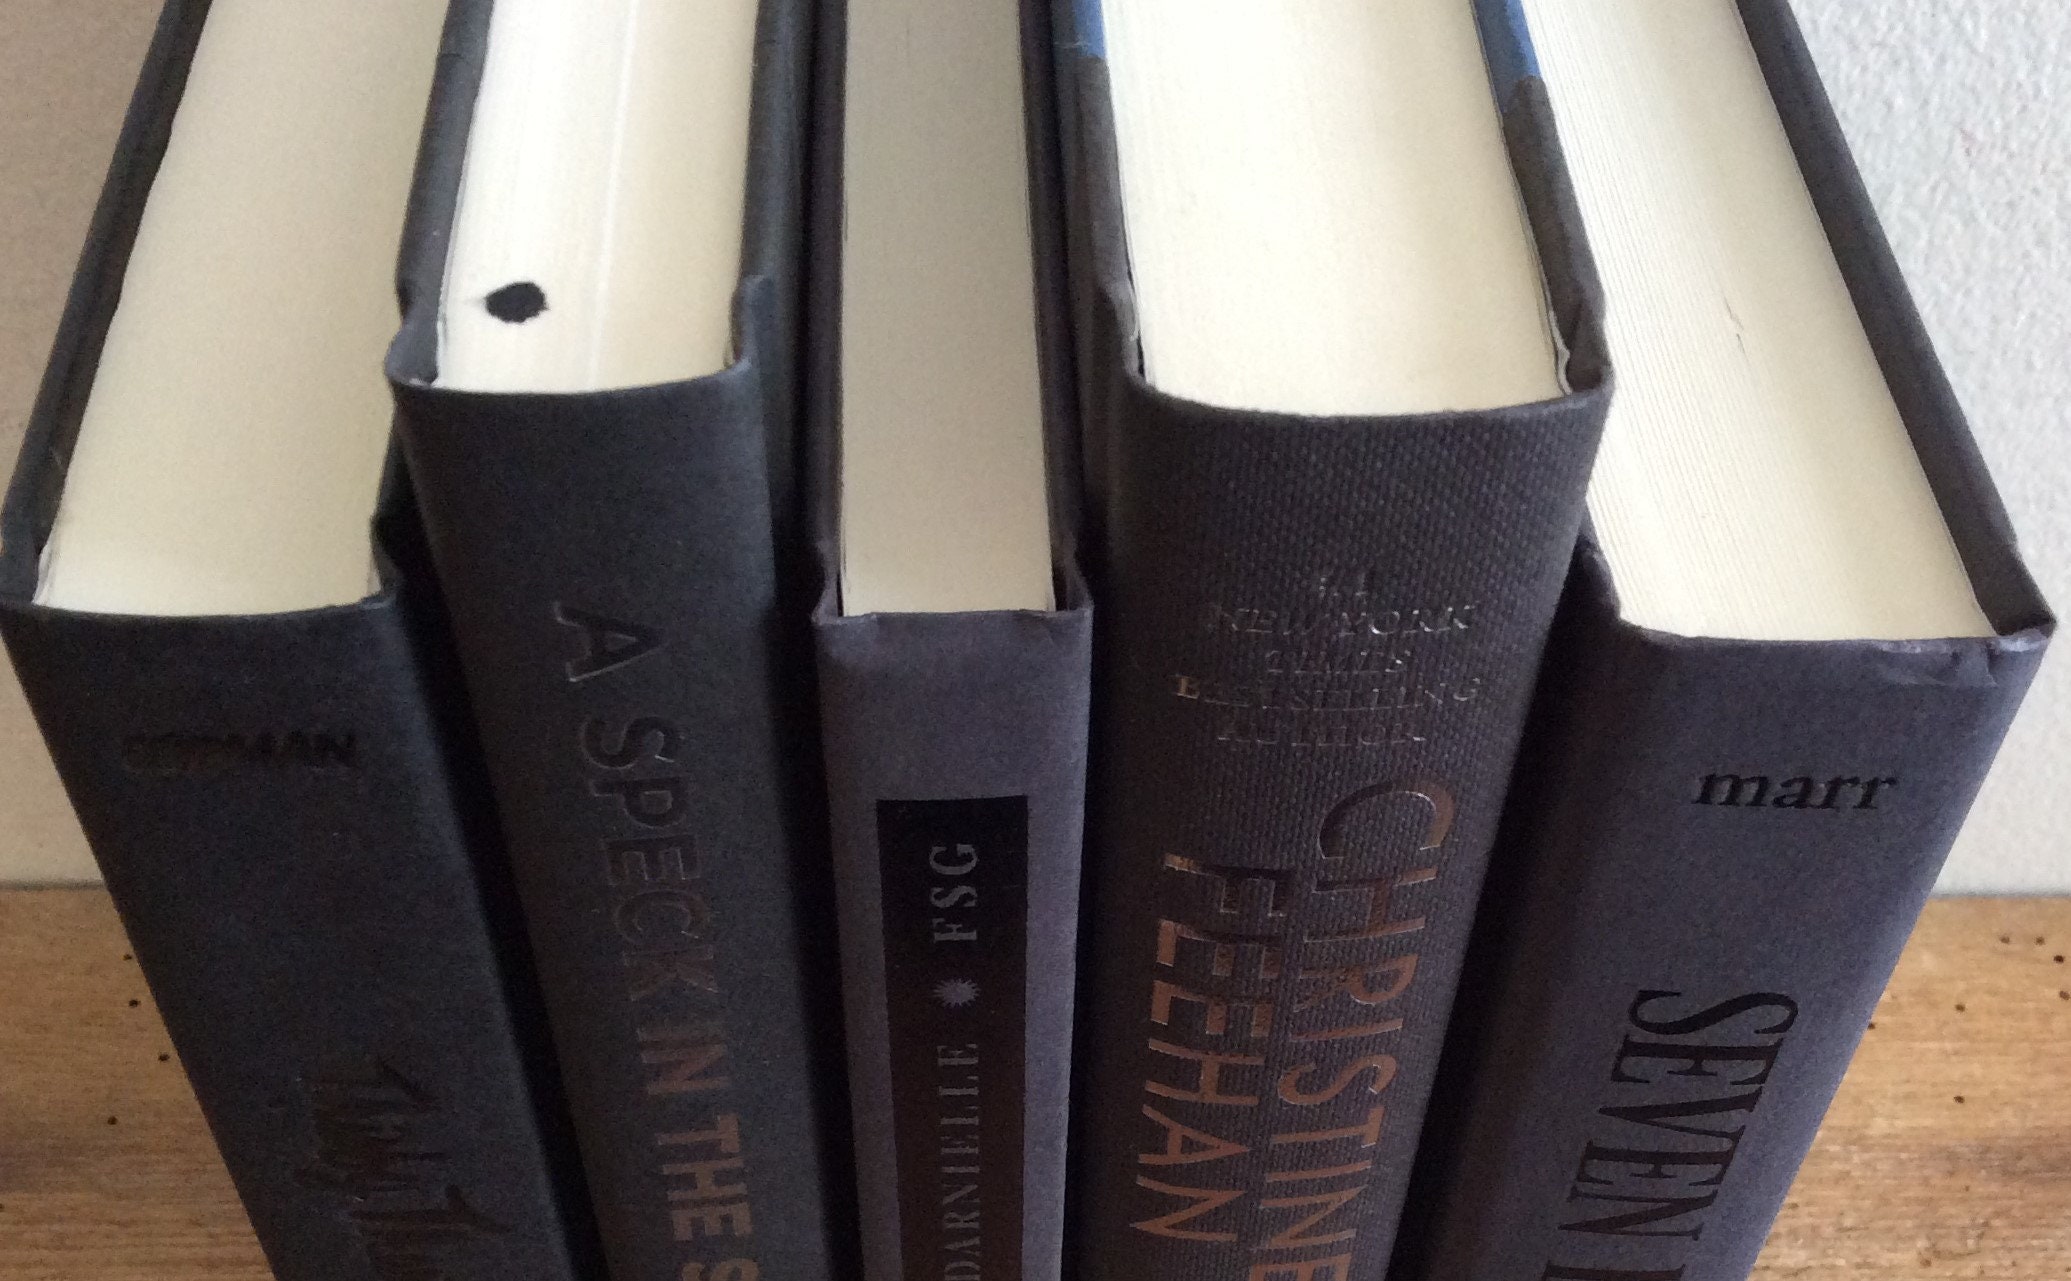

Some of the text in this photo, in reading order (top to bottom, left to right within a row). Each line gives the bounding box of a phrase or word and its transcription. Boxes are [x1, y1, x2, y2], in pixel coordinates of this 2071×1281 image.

[553, 600, 668, 683] A
[580, 716, 719, 1001] SPECK
[1694, 771, 1897, 811] marr
[928, 842, 980, 944] FSG
[636, 1017, 731, 1094] IN
[1130, 852, 1299, 1244] FEEHAN
[1248, 775, 1457, 1281] CHRISTINE
[1557, 988, 1799, 1242] SEVEN
[657, 1112, 752, 1242] THE
[936, 1042, 982, 1281] DARNIELLE
